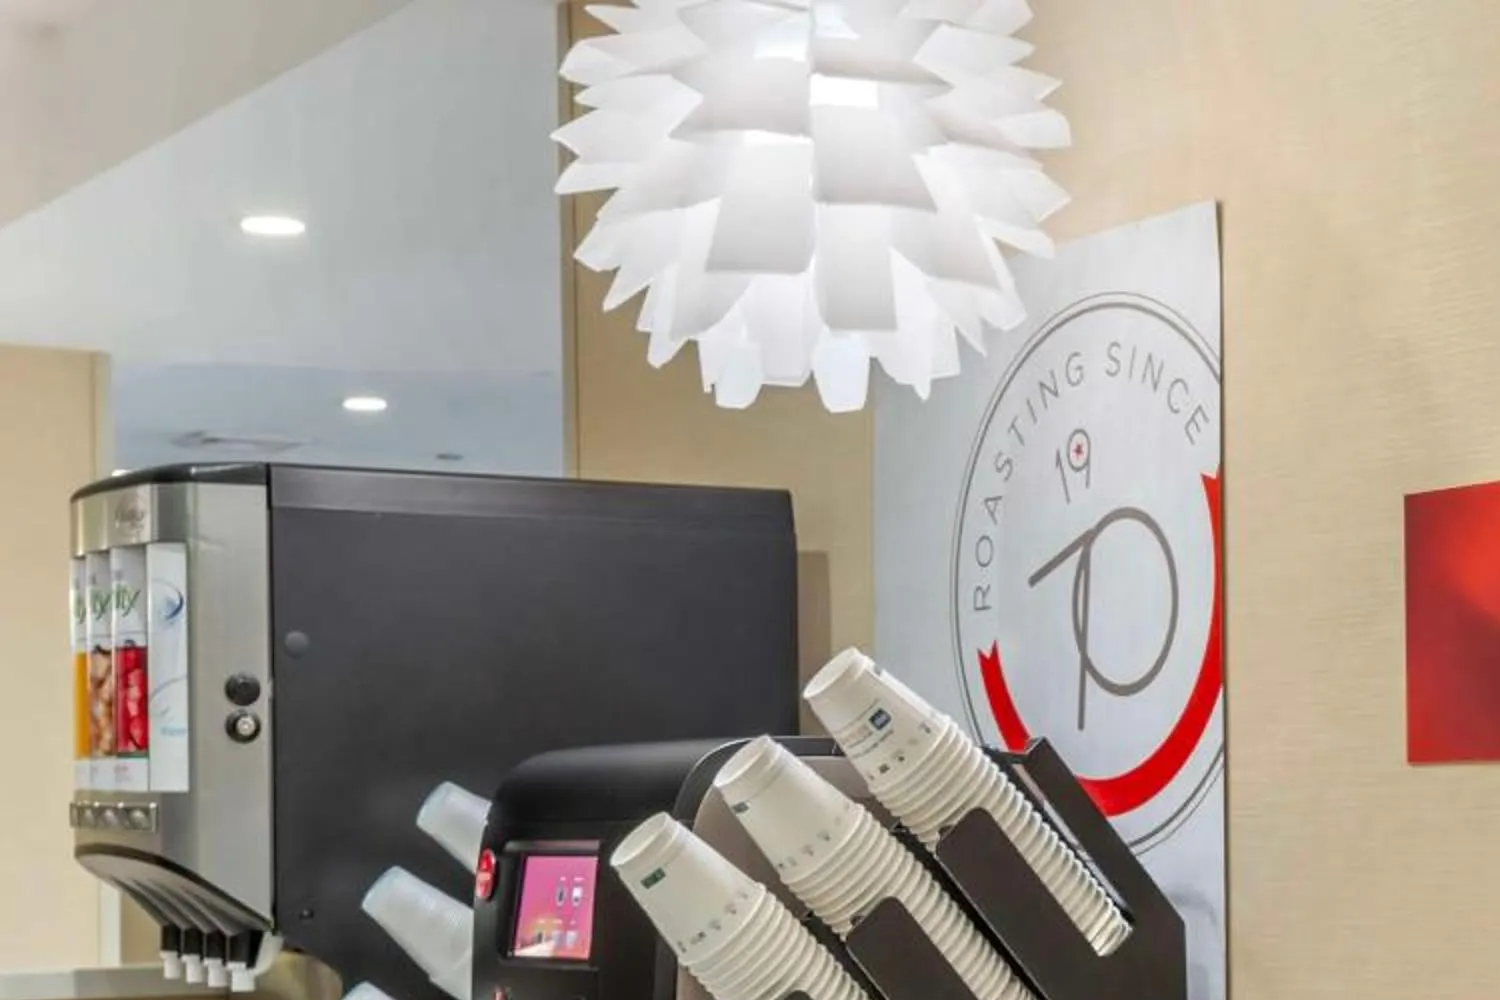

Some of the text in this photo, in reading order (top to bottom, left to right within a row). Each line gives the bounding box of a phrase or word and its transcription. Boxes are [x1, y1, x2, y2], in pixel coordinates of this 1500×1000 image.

[972, 340, 1211, 612] ROASTING SINCE
[1054, 428, 1092, 504] 19
